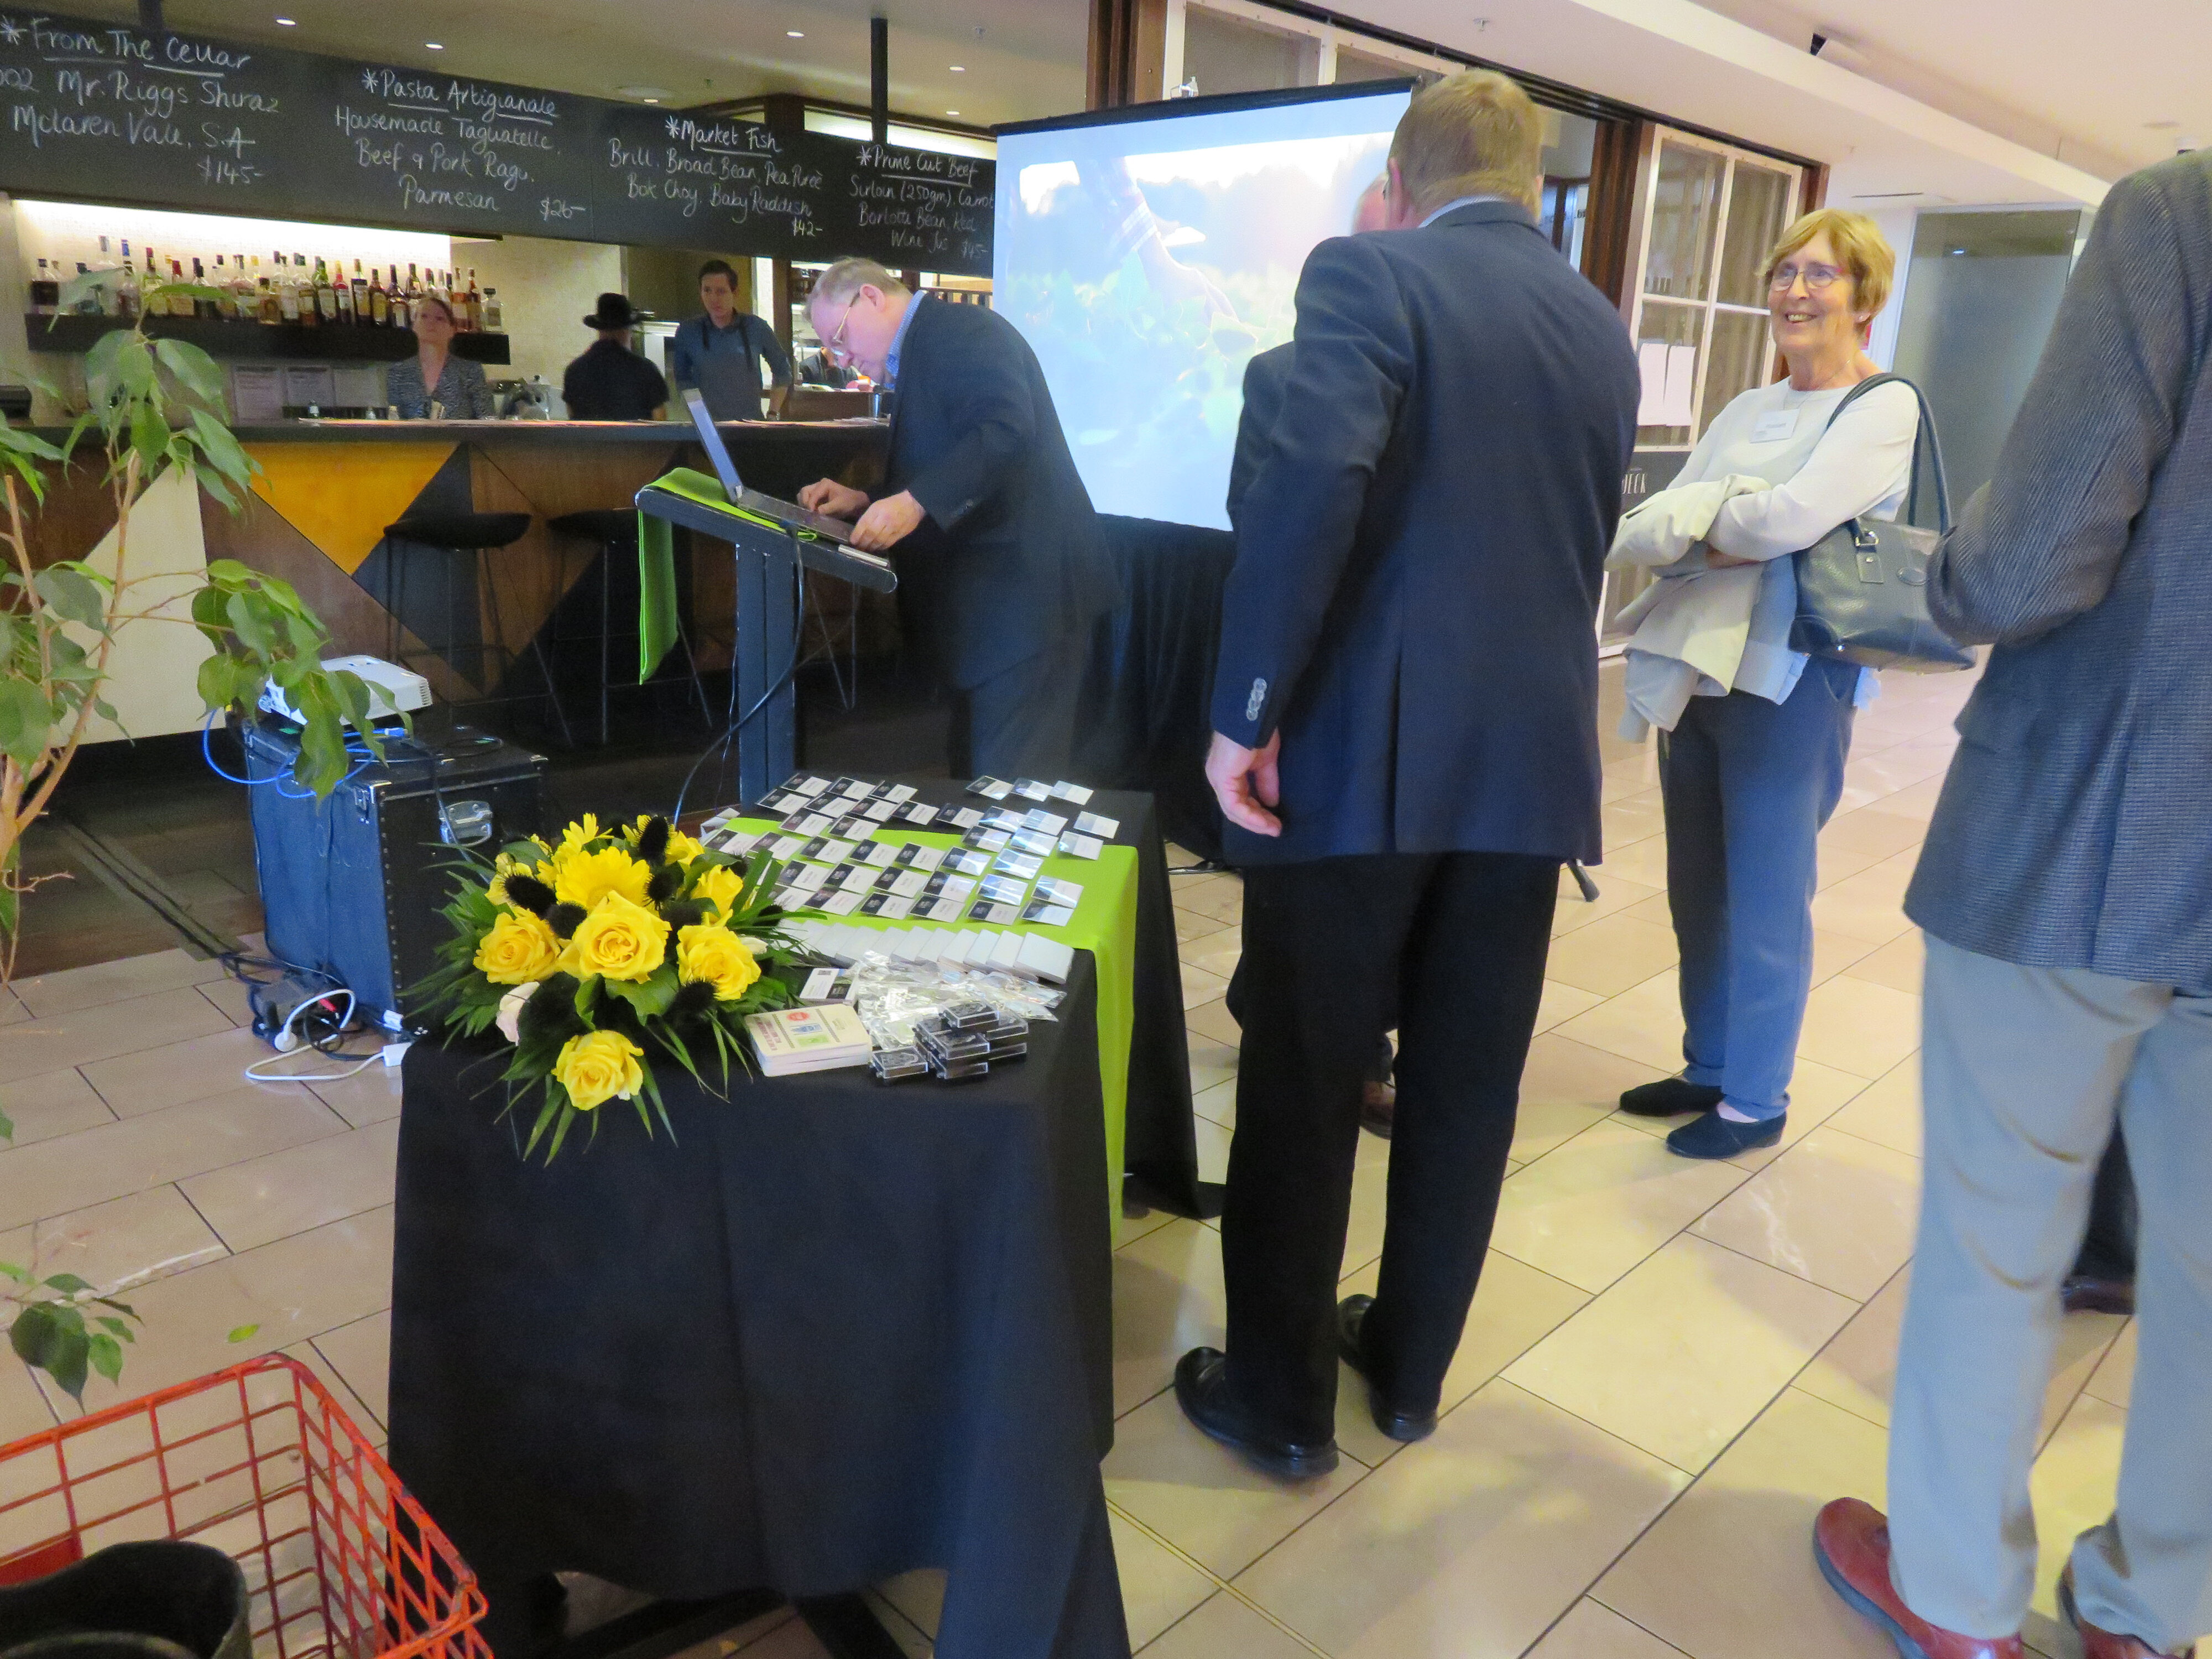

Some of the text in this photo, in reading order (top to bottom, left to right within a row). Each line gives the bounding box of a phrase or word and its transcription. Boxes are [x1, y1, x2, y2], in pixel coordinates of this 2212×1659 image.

[31, 17, 104, 54] From
[106, 30, 154, 61] The
[108, 70, 189, 119] Riggs
[380, 69, 439, 101] Pasta
[335, 106, 444, 137] Housemade
[681, 119, 783, 153] Market Fish
[356, 137, 404, 171] Beef
[431, 142, 473, 177] Pork
[666, 147, 717, 175] Broad
[765, 160, 791, 186] Pea
[868, 144, 978, 186] Prime Cut Beef
[399, 174, 499, 211] Parmesan
[628, 173, 657, 200] Bok
[710, 183, 748, 224] Baby
[850, 174, 895, 199] Sirloin
[891, 229, 923, 247] Wine
